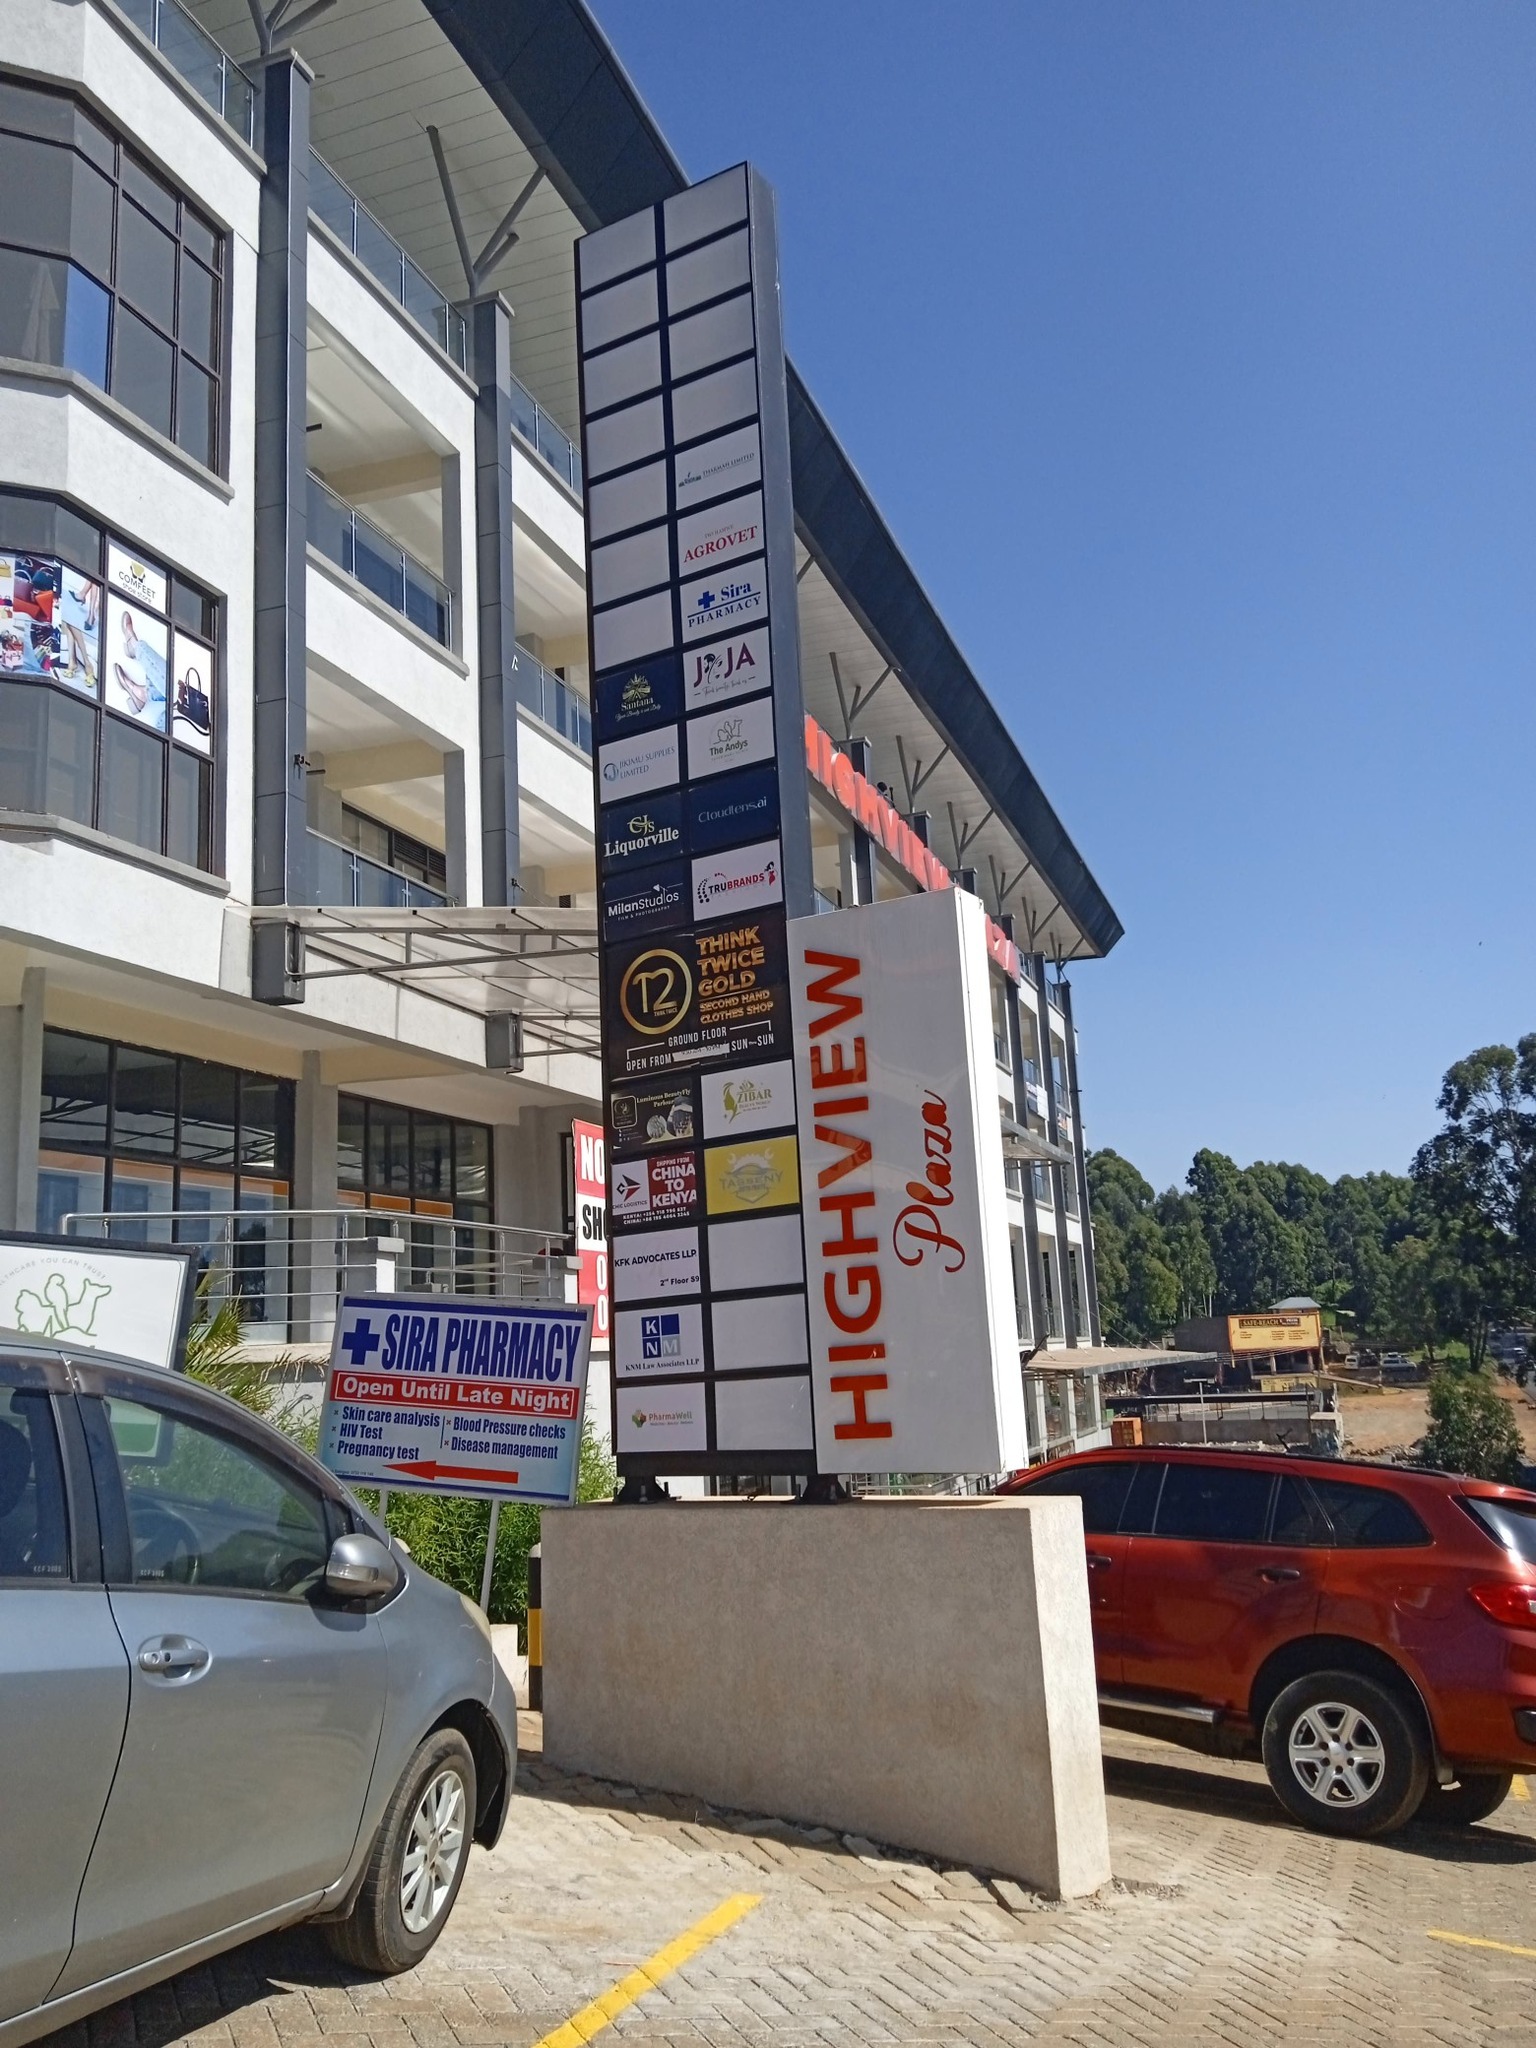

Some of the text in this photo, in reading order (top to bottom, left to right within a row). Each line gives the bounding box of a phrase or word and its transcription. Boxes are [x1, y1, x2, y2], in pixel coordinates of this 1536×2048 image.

[684, 525, 758, 562] AGROVET
[118, 571, 156, 598] COMFEET
[720, 581, 752, 602] Sira
[688, 596, 761, 628] PHARMACY
[621, 698, 654, 711] Santana
[646, 746, 675, 762] SUPPLIES
[710, 746, 724, 756] The
[725, 740, 748, 752] Andys
[620, 764, 650, 778] LIMITED
[604, 827, 680, 858] Liquorville
[708, 872, 764, 894] TRUBRANDS
[608, 889, 679, 916] MilanStudios
[636, 906, 670, 916] PHOTOGRAPHY
[696, 926, 760, 955] THINK
[697, 946, 765, 976] TWICE
[698, 970, 756, 997] GOLD
[700, 989, 770, 1012] SECOND HAND
[700, 1000, 774, 1024] CLOTHES SHOP
[668, 1026, 727, 1047] GROUND FLOOR
[626, 1057, 647, 1072] OPEN
[650, 1053, 672, 1067] FROM
[738, 1088, 772, 1103] ZIBAR
[652, 1163, 696, 1181] CHINA
[656, 1156, 690, 1167] SHIPPING FROM
[664, 1178, 685, 1192] TO
[892, 1089, 966, 1273] Plaza
[624, 1200, 648, 1208] LOGISTICS
[652, 1190, 697, 1208] KENYA
[804, 949, 893, 1440] HIGHVIEW
[62, 1258, 80, 1266] CAN
[83, 1262, 106, 1279] TRUST
[614, 1249, 696, 1267] KFK ADVOCATES LLP
[646, 1320, 657, 1334] K
[382, 1314, 581, 1382] SIRA PHARMACY
[646, 1340, 678, 1356] N M
[626, 1363, 641, 1371] KNM
[656, 1360, 685, 1368] Associates
[686, 1358, 700, 1366] LLP
[343, 1377, 570, 1412] Open Until Late Night
[342, 1406, 440, 1428] Skin care analysis
[648, 1410, 692, 1420] PharmaWell
[340, 1424, 382, 1440] HIV Test
[454, 1416, 566, 1439] Blood Pressure checks
[337, 1440, 420, 1461] Pregnancy test
[452, 1436, 558, 1460] Disease management
